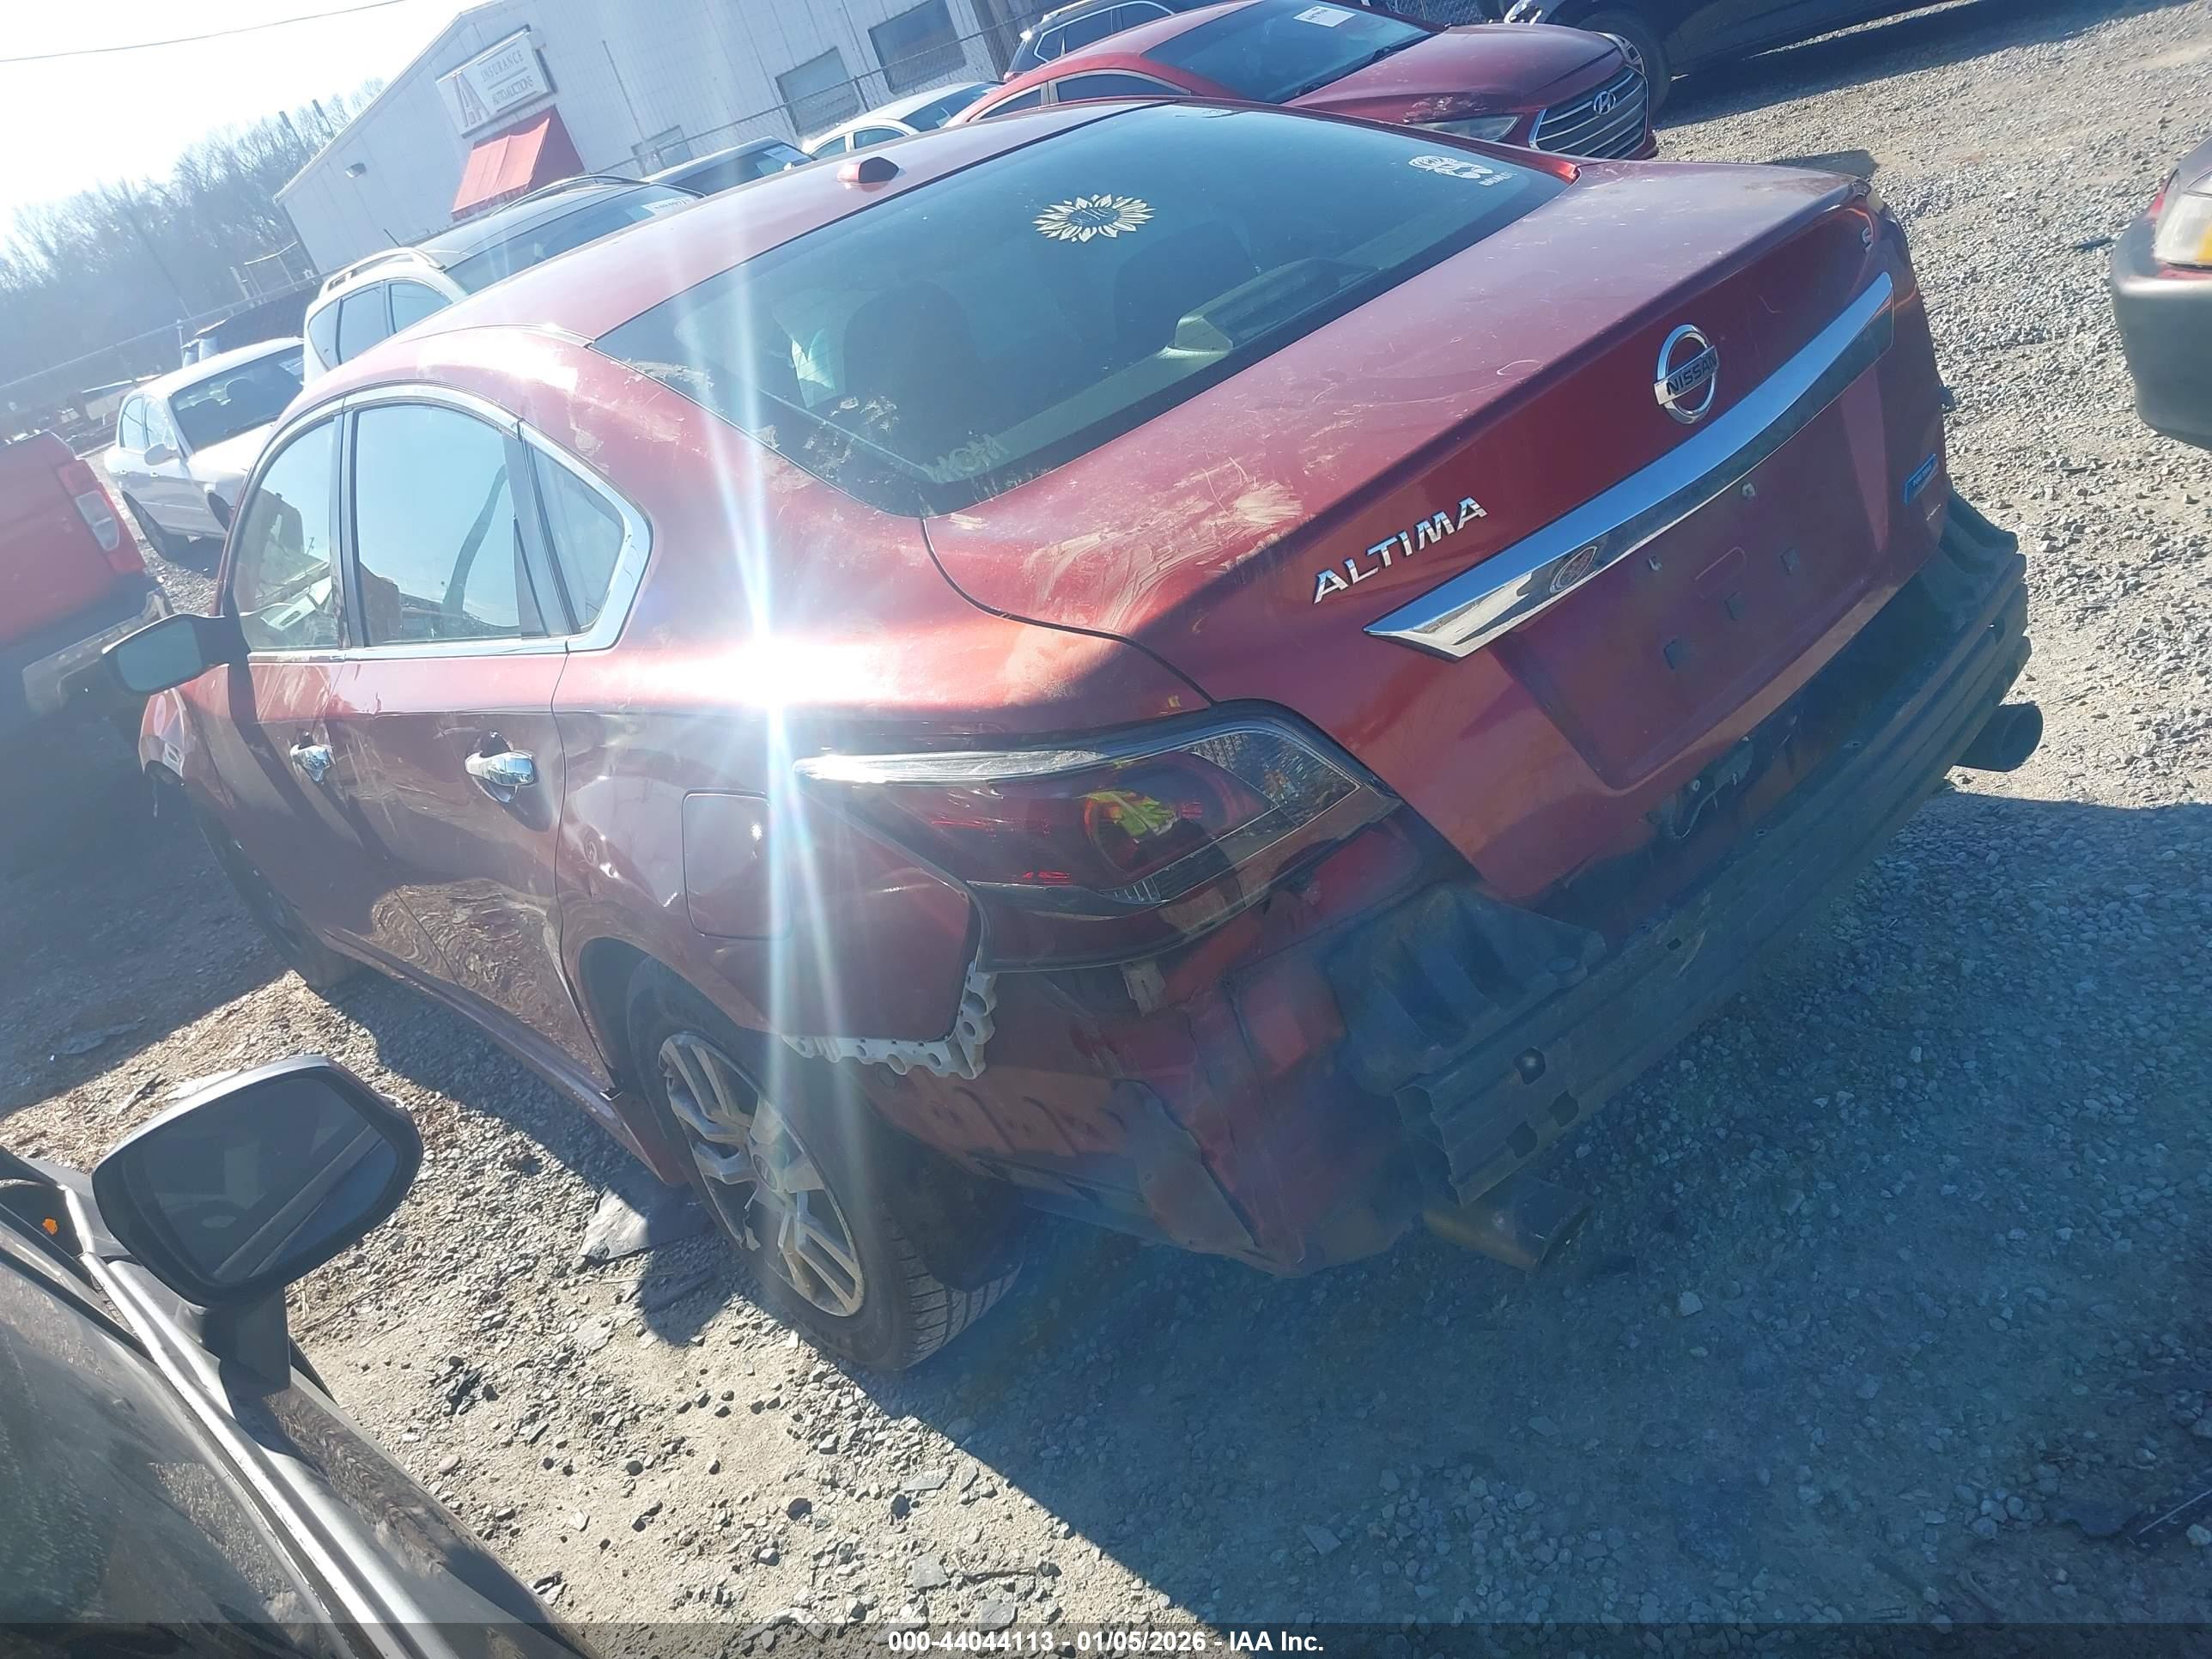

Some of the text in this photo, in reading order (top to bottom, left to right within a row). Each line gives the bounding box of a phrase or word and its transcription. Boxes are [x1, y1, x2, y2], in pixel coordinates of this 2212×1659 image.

[479, 50, 524, 82] INSURANCE
[1666, 354, 1717, 396] NISSAN
[1313, 495, 1488, 605] ALTIMA
